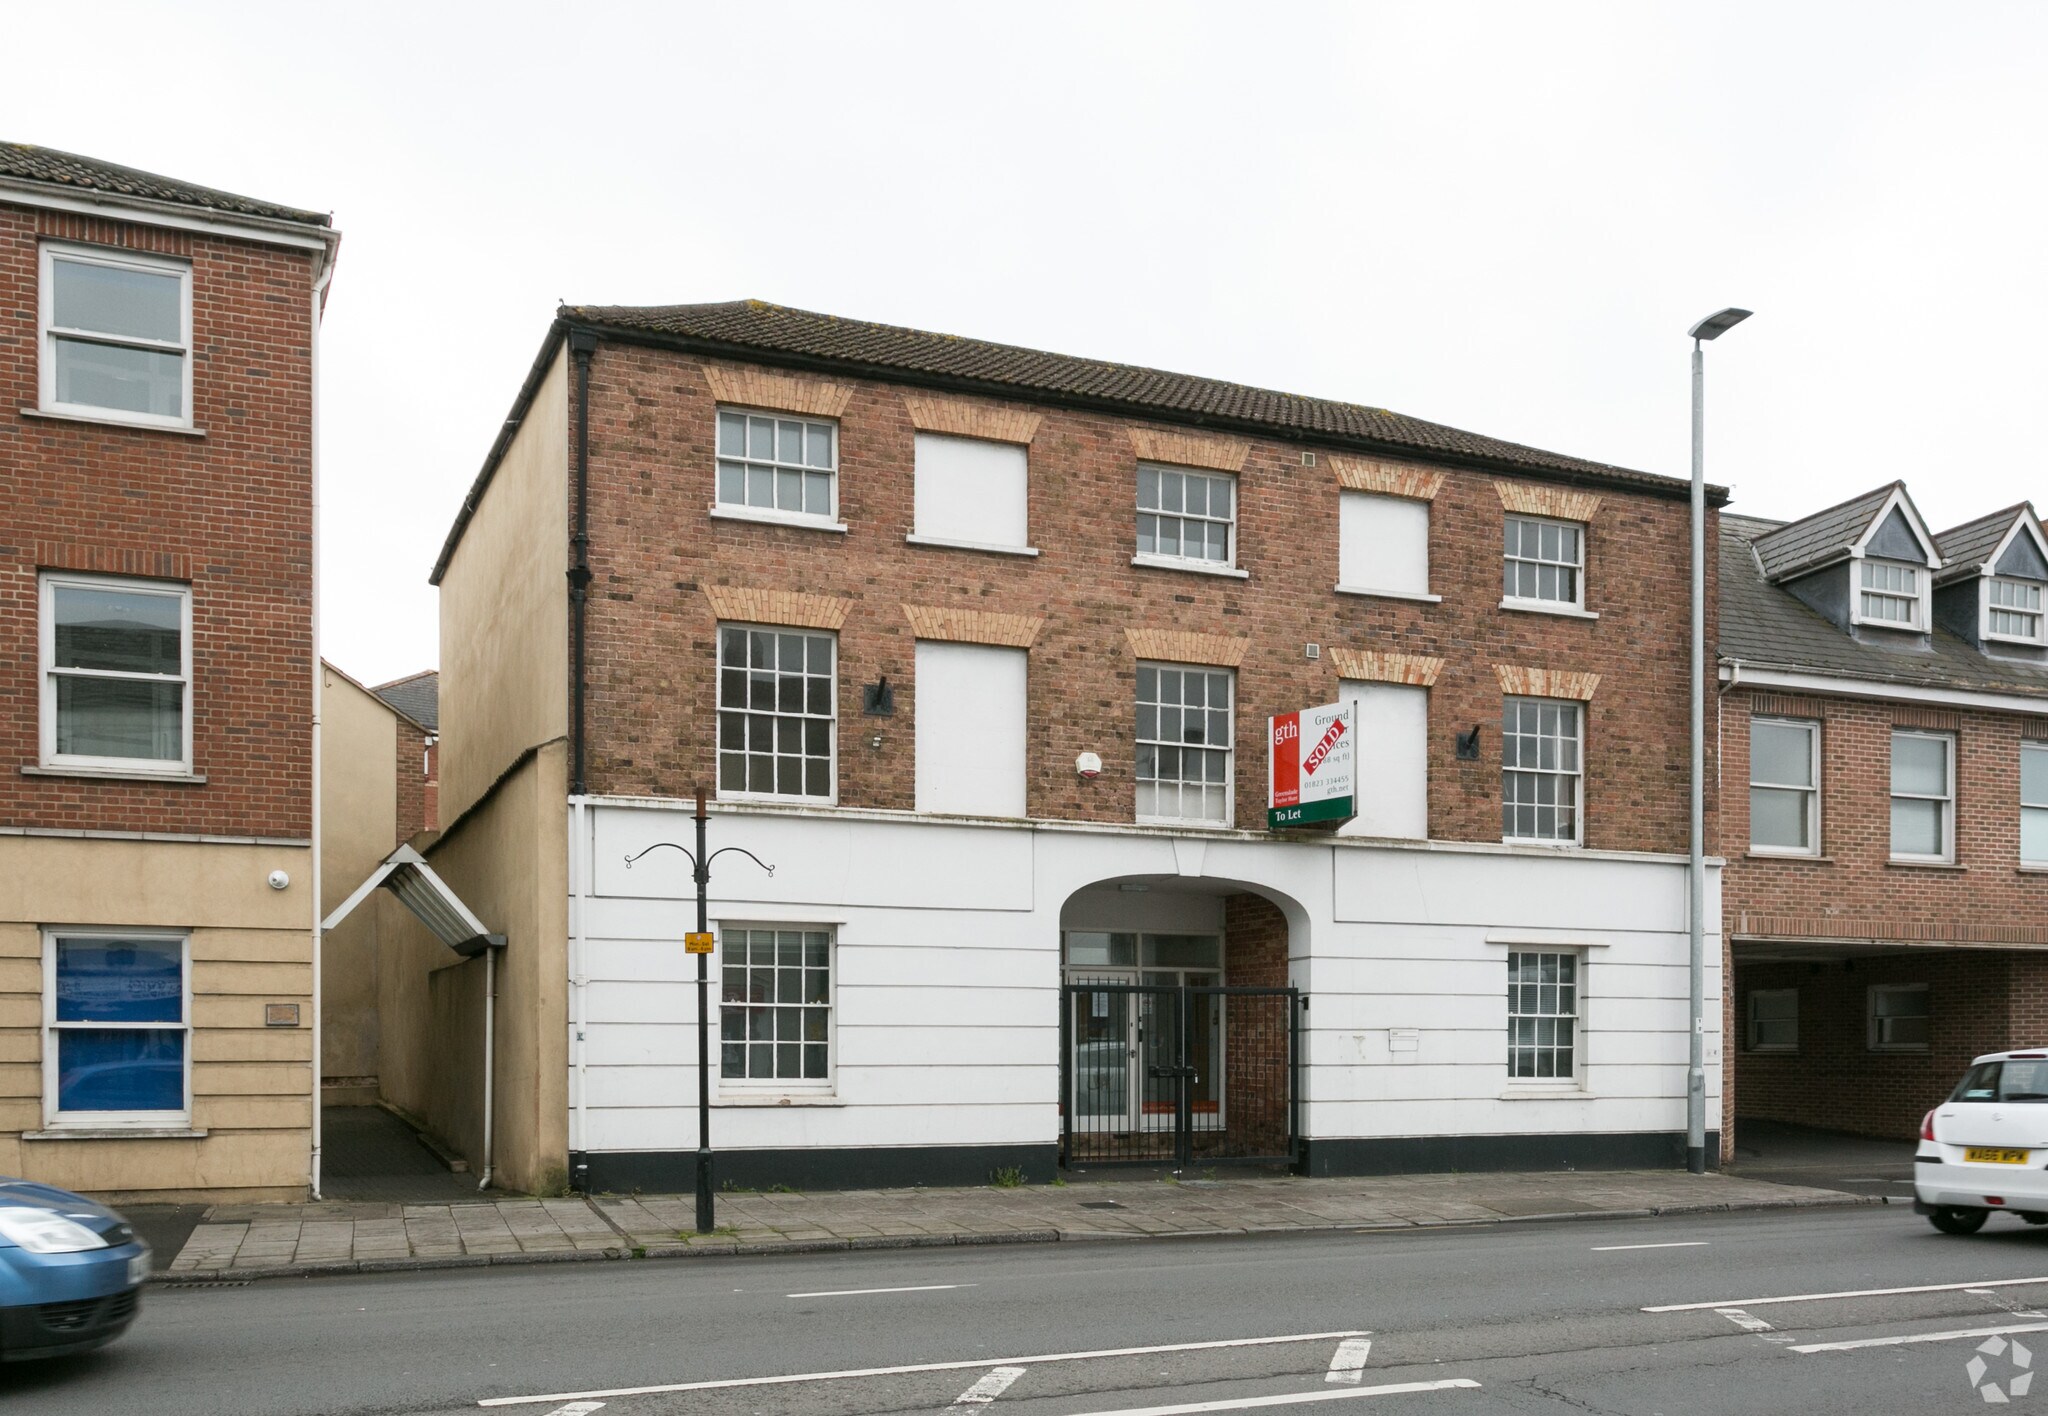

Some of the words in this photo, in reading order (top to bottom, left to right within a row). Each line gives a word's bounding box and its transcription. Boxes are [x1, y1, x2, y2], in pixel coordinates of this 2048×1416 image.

[1315, 709, 1349, 726] Ground
[1274, 721, 1298, 745] gth
[1308, 726, 1340, 770] SOLD
[1304, 779, 1324, 789] 01823
[1327, 785, 1349, 795] gth.net
[1275, 811, 1286, 822] To
[1288, 809, 1301, 820] Let
